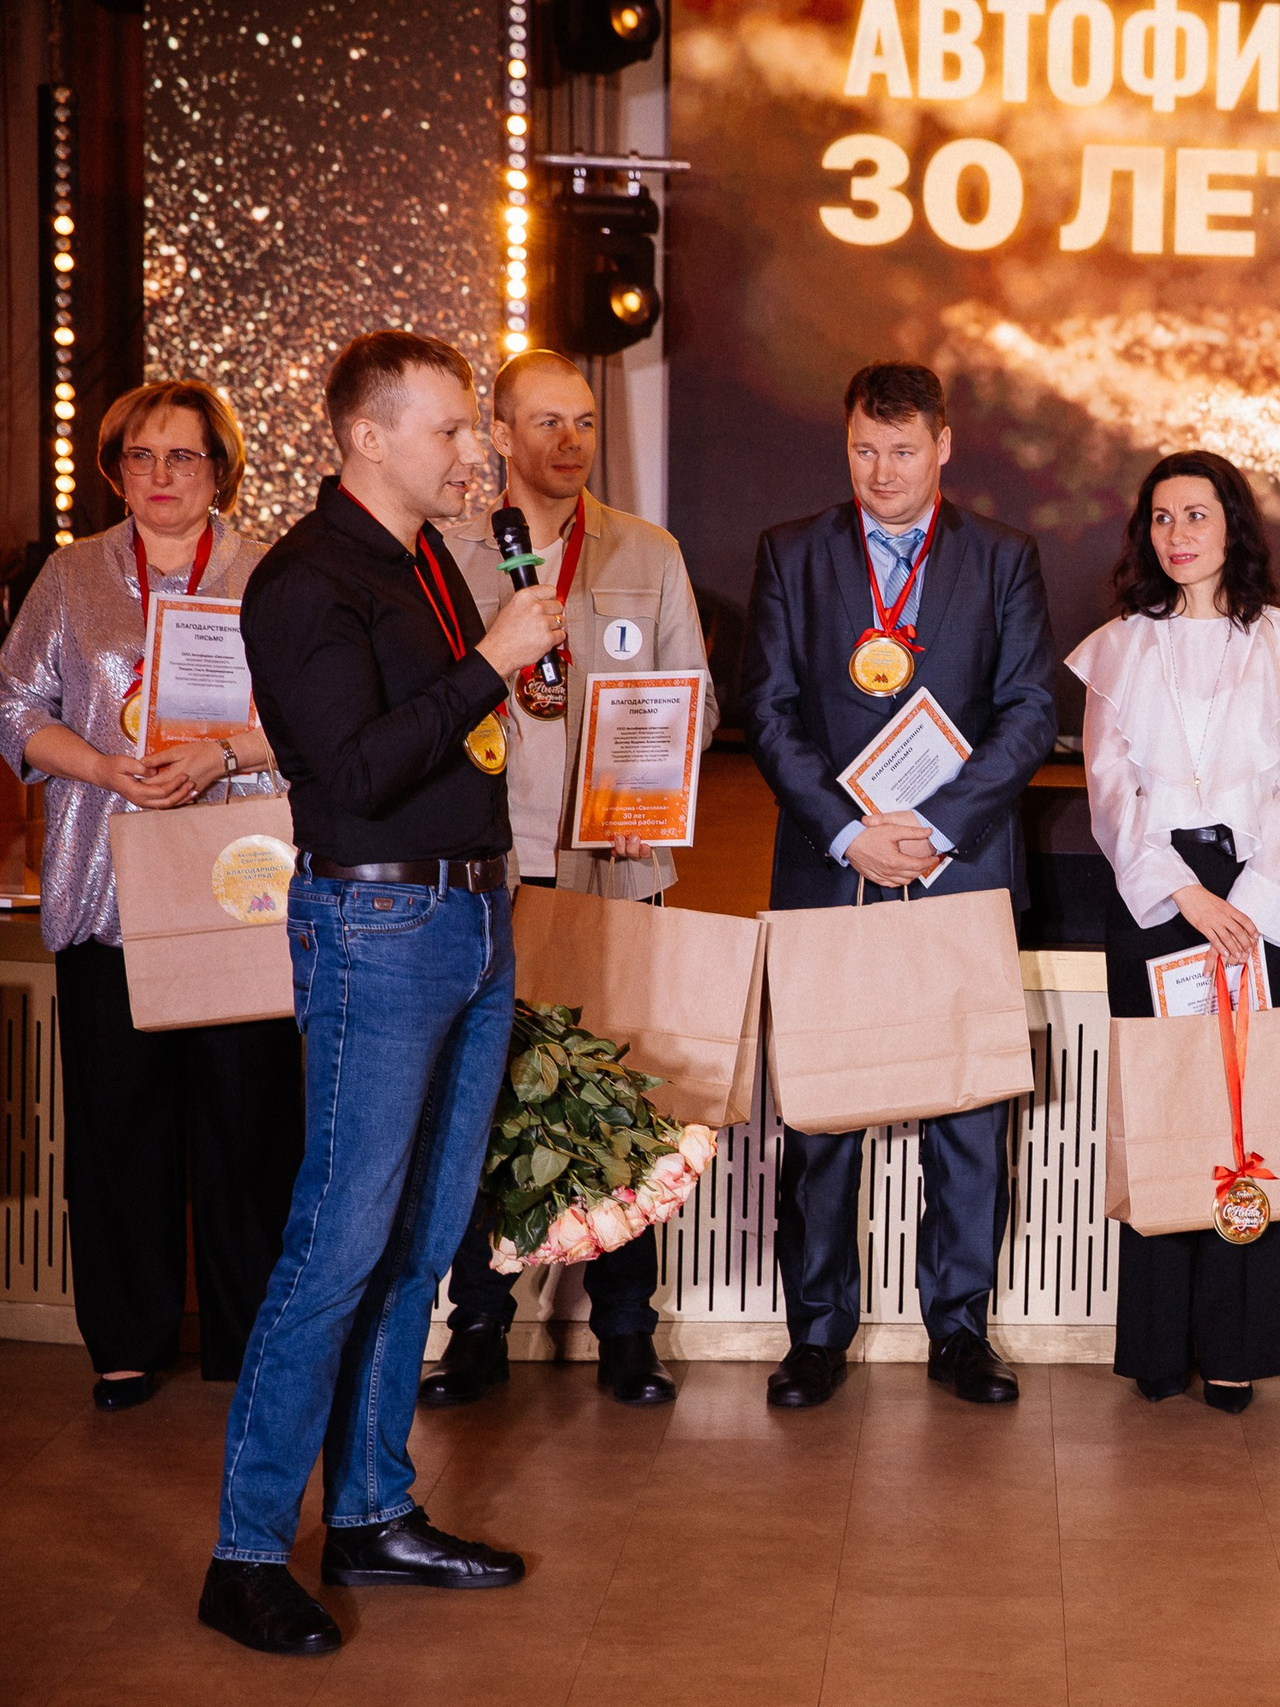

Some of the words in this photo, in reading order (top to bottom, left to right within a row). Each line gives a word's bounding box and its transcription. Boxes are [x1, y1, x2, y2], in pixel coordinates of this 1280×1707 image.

[819, 133, 1025, 251] 30
[175, 623, 240, 633] БЛАГОДАРСТВЕННО
[195, 634, 223, 642] ПИСЬМО
[614, 625, 630, 653] 1
[611, 698, 681, 706] БЛАГОДАРСТВЕННОЕ
[871, 723, 925, 781] БЛАГОДАРСТВЕННОЕ
[890, 747, 914, 772] ПИСЬМО
[622, 812, 632, 820] 30
[601, 819, 637, 827] успешной
[637, 818, 667, 827] работы!
[226, 865, 290, 876] БЛАГОДАРНОСТЬ
